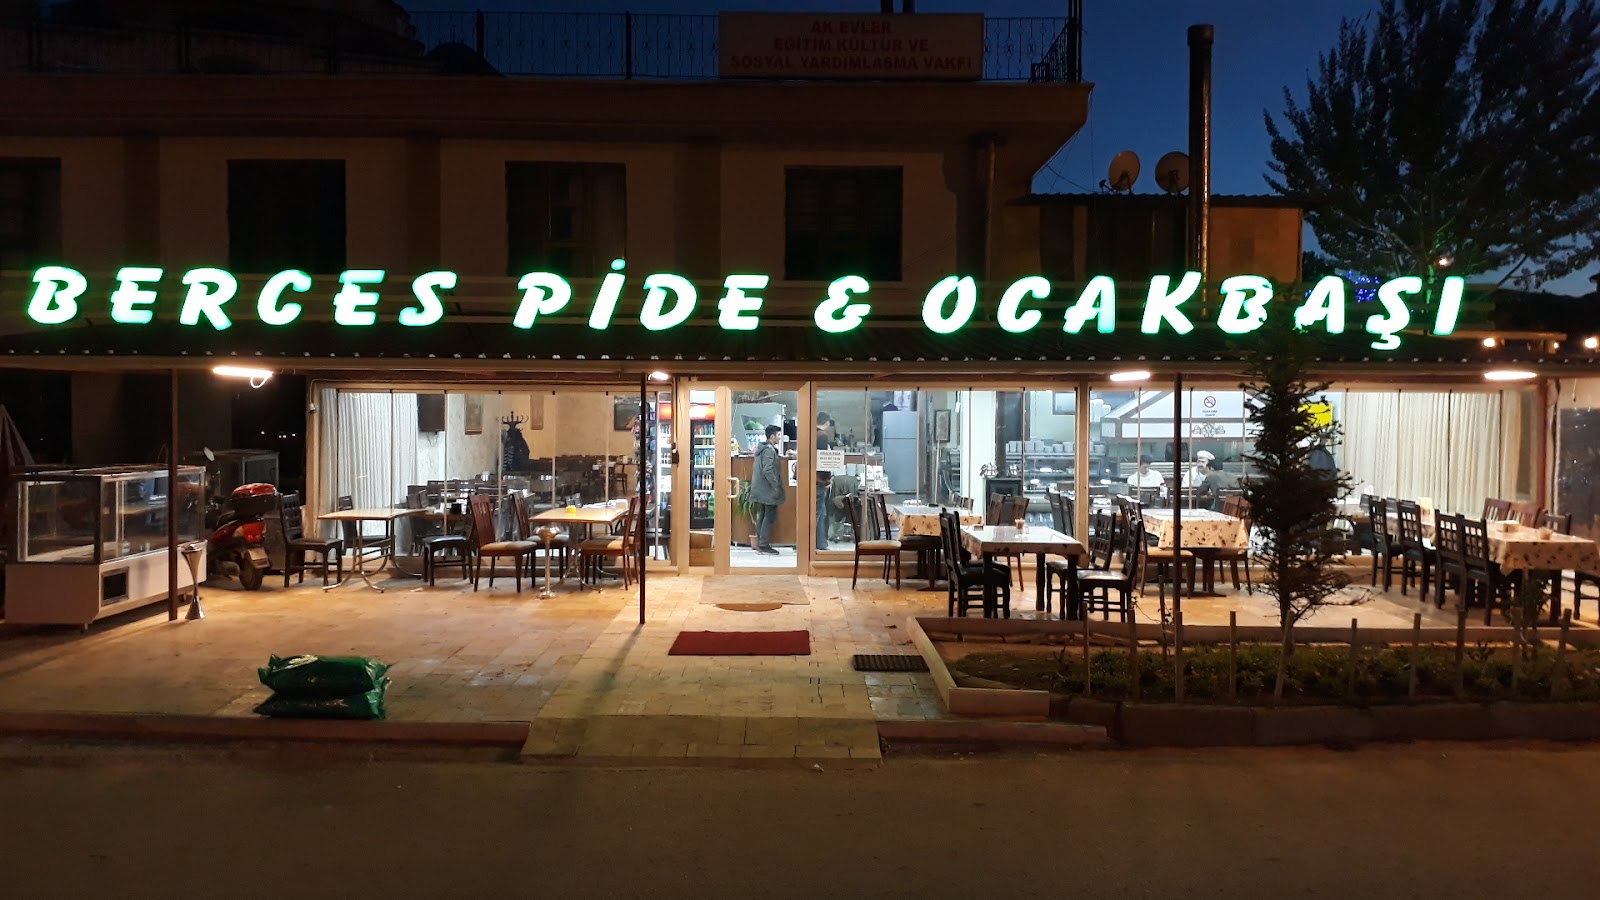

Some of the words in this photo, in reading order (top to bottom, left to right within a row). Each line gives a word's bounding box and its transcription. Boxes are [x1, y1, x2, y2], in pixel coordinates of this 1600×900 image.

[811, 20, 833, 34] AK
[839, 20, 892, 34] EVLER
[908, 38, 929, 52] VE
[730, 54, 791, 69] SOSYAL
[27, 265, 458, 328] BERCES
[512, 258, 770, 331] PİDE
[814, 275, 872, 334] &
[921, 271, 1465, 350] OCAKBAŞI
